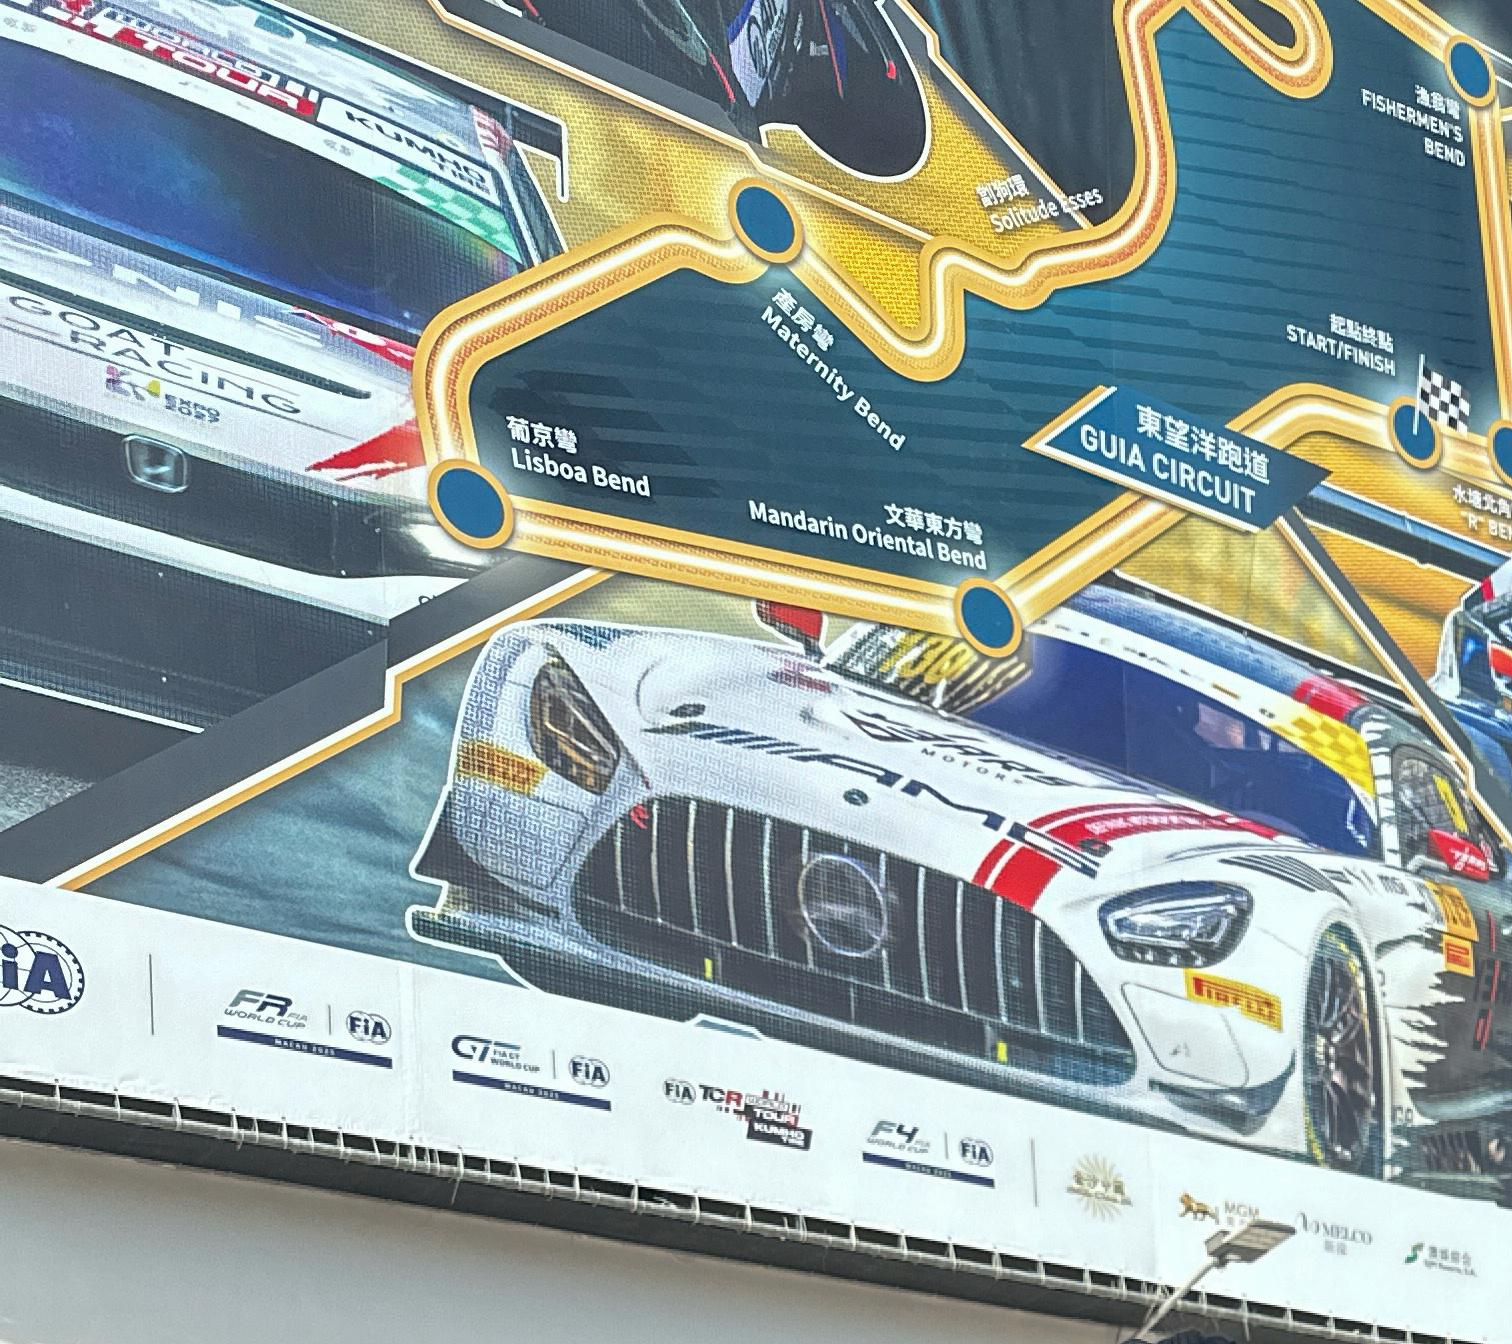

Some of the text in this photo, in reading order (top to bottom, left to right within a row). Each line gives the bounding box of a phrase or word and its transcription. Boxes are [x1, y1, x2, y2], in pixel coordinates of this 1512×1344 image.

[134, 28, 300, 110] TOUR
[1361, 88, 1464, 143] FISHERMEN'S
[345, 110, 486, 184] KUMHO
[1424, 137, 1466, 167] BEND
[990, 198, 1059, 233] Solitude
[8, 295, 185, 358] GOAT
[1286, 323, 1396, 377] START/FINISH
[70, 329, 302, 414] RACING
[760, 305, 907, 451] Maternity Bend
[1080, 423, 1256, 514] GUIA CIRCUIT
[1136, 404, 1270, 485] 東望洋跑道
[511, 447, 651, 498] Lisboa Bend
[749, 500, 987, 570] Mandarin Oriental Bend
[921, 747, 1025, 786] MOTORS
[224, 1008, 306, 1030] WORLD CUP
[229, 989, 293, 1018] FR
[1193, 976, 1277, 1026] PIRELLI
[491, 1058, 540, 1073] WORLD CUP
[699, 1085, 743, 1107] TCR
[754, 1108, 799, 1127] TOUR
[754, 1123, 805, 1140] KUMHO
[867, 1137, 906, 1150] WORLD
[871, 1120, 919, 1143] F4
